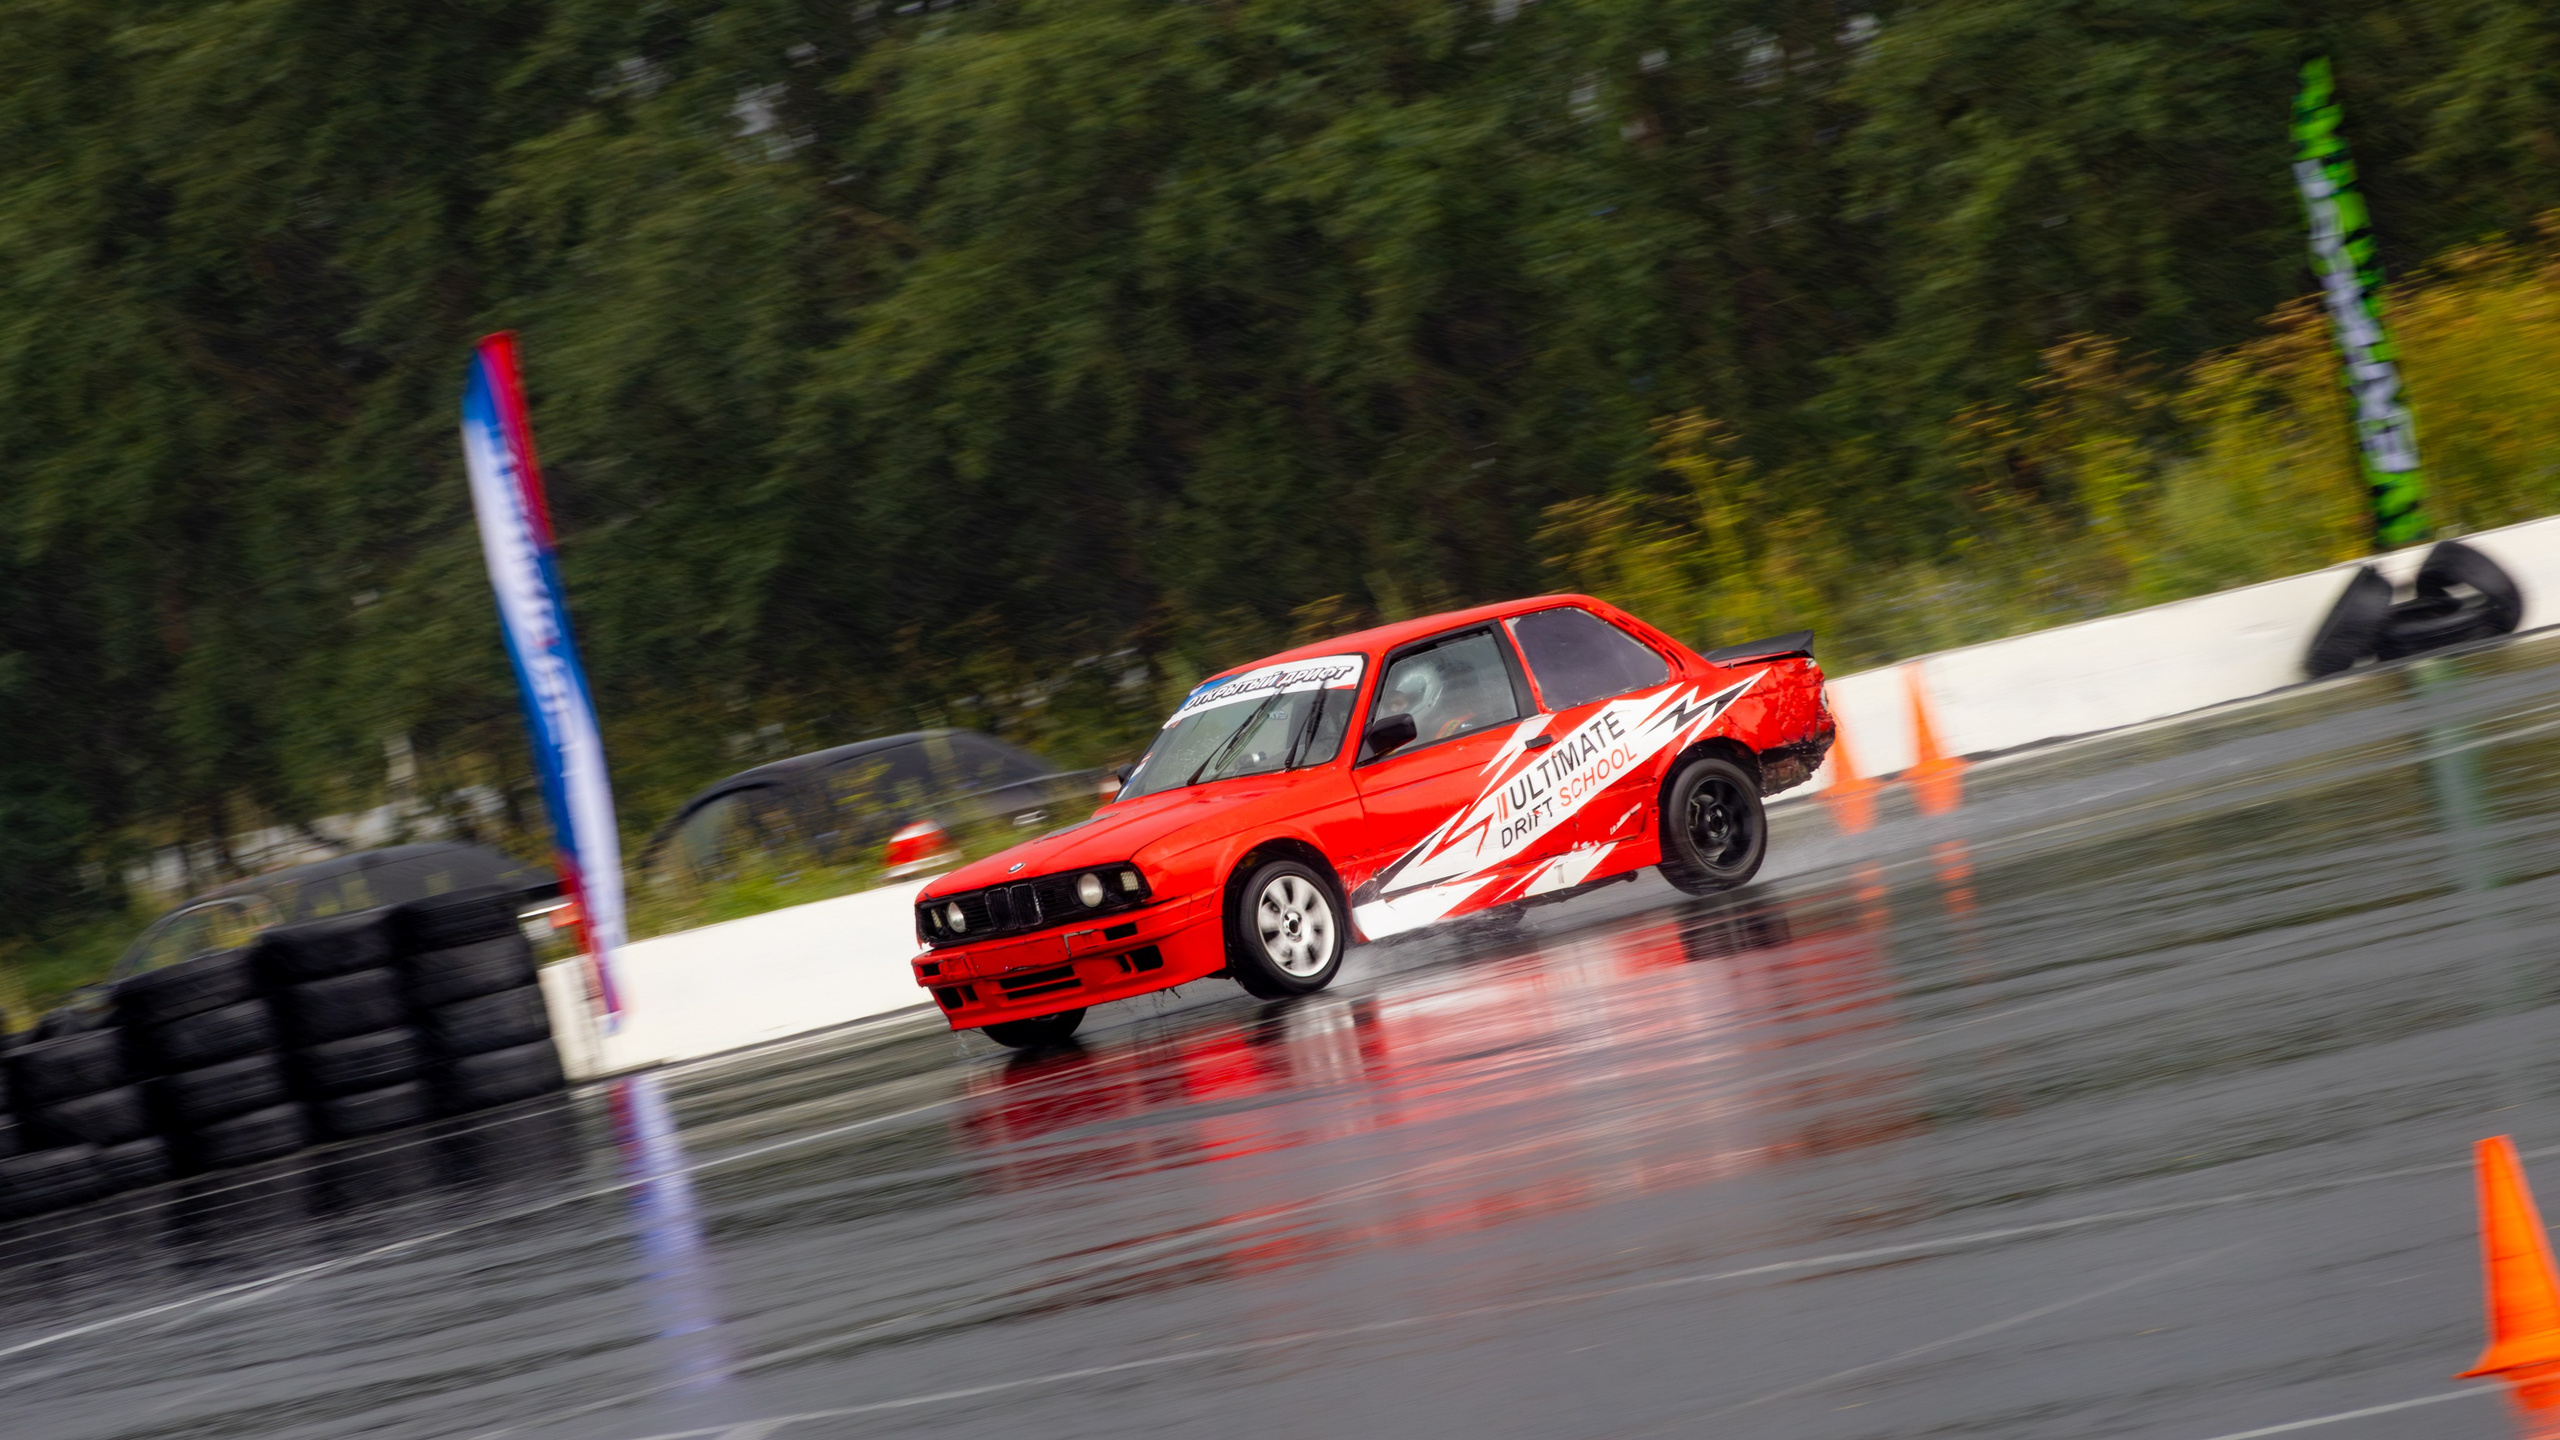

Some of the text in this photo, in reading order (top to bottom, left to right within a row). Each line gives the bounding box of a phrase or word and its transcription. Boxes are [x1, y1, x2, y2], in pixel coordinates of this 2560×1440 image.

[1185, 665, 1354, 711] ОТКРЫТЫЙ ДРИФТ
[1502, 743, 1638, 850] DRIFT SCHOOL
[1509, 711, 1626, 810] ULTIMATE
